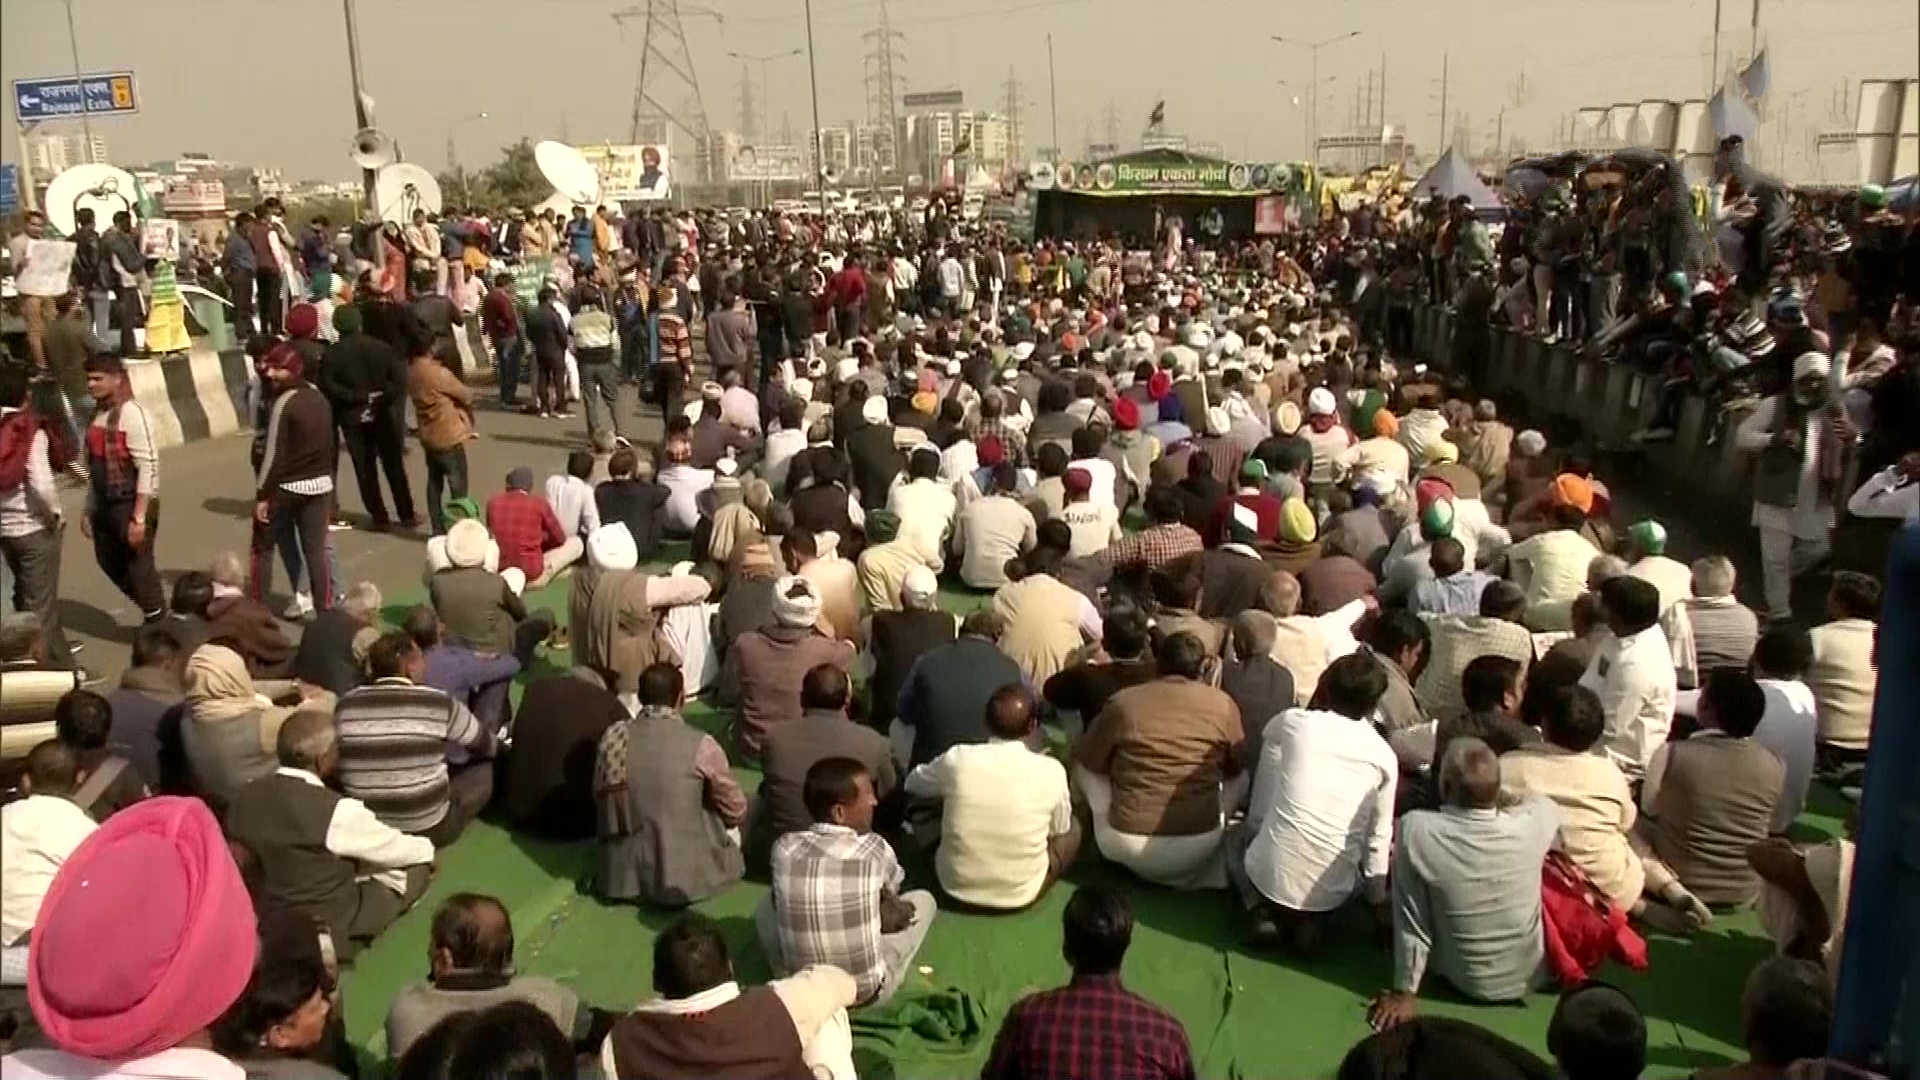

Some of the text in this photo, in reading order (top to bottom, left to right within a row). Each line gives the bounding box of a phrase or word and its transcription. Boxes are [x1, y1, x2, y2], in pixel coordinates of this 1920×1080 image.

[1118, 164, 1228, 182] किसान एकता मोर्चा
